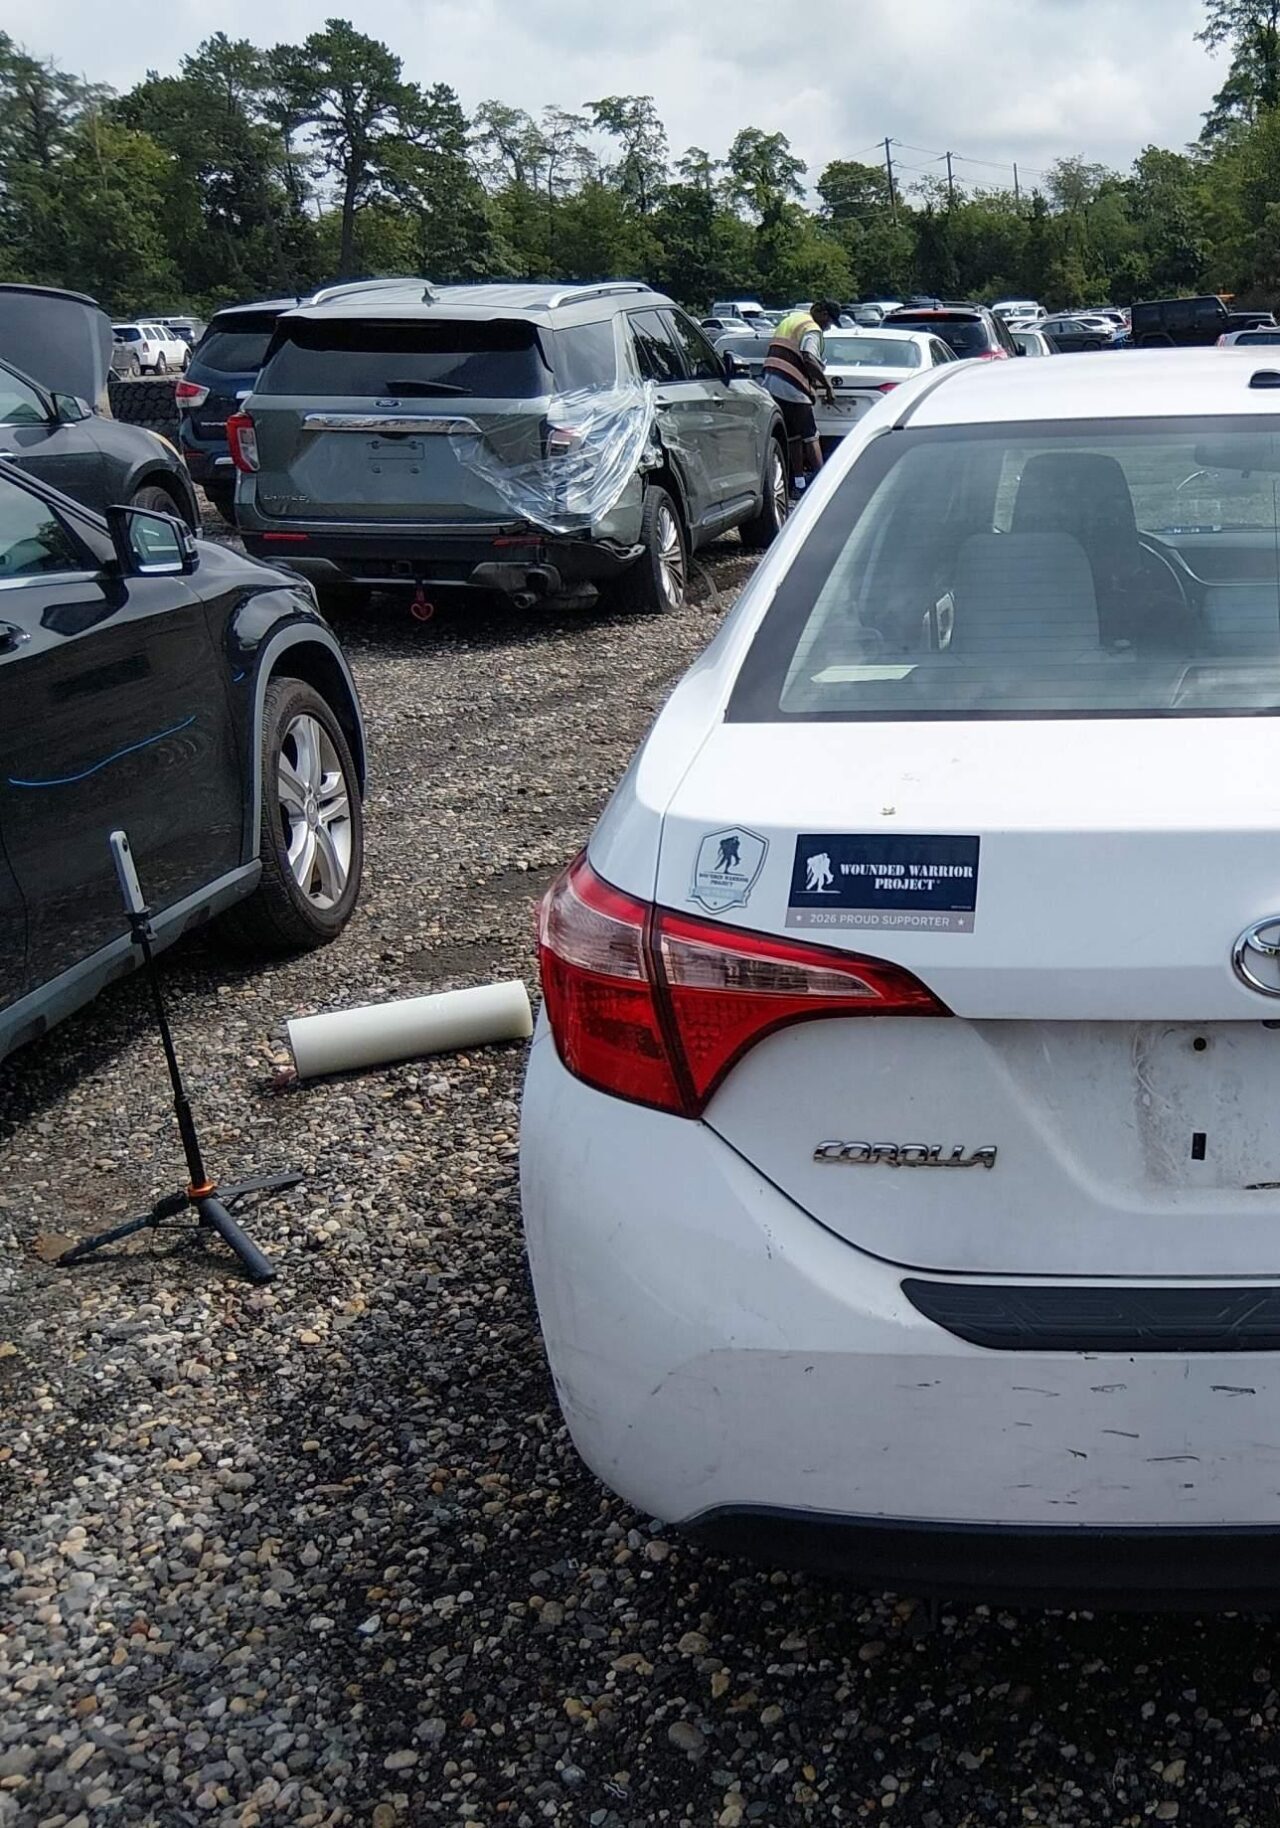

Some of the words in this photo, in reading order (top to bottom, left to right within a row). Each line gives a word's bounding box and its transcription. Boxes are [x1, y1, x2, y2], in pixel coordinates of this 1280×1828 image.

[840, 863, 905, 876] WOUNDED
[908, 864, 974, 879] WARRIOR
[874, 877, 934, 891] PROJECT
[810, 913, 837, 924] 2026
[839, 914, 880, 925] PROUD
[881, 915, 950, 927] SUPPORTER
[813, 1140, 998, 1169] COROLLA
